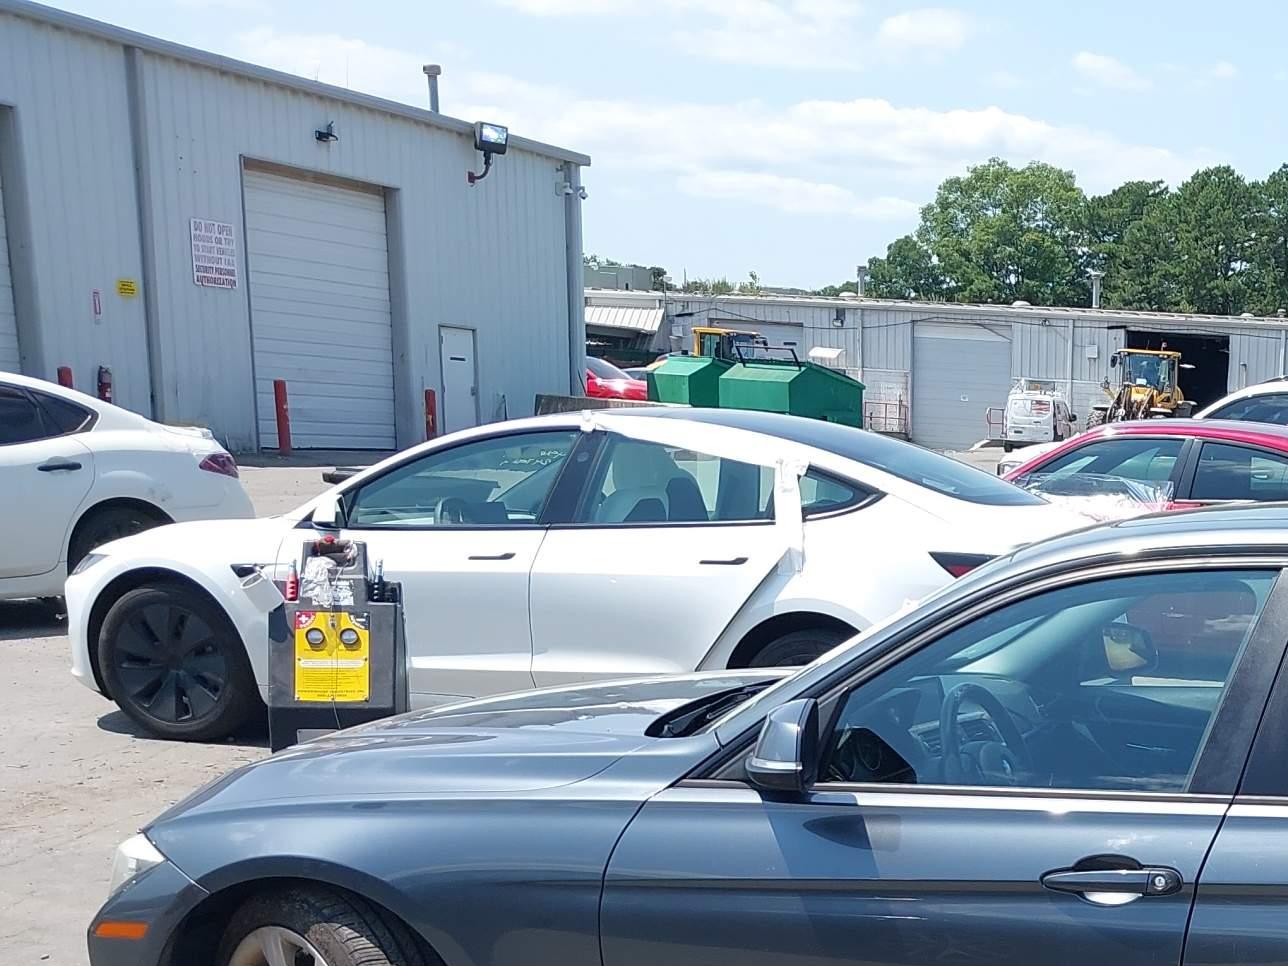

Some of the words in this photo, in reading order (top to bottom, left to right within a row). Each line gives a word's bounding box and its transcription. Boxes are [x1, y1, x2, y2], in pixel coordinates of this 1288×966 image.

[194, 221, 202, 232] DO
[204, 223, 216, 235] NOT
[217, 224, 233, 237] OPEN
[215, 236, 222, 245] OR
[196, 275, 237, 287] AUTHORIZATION
